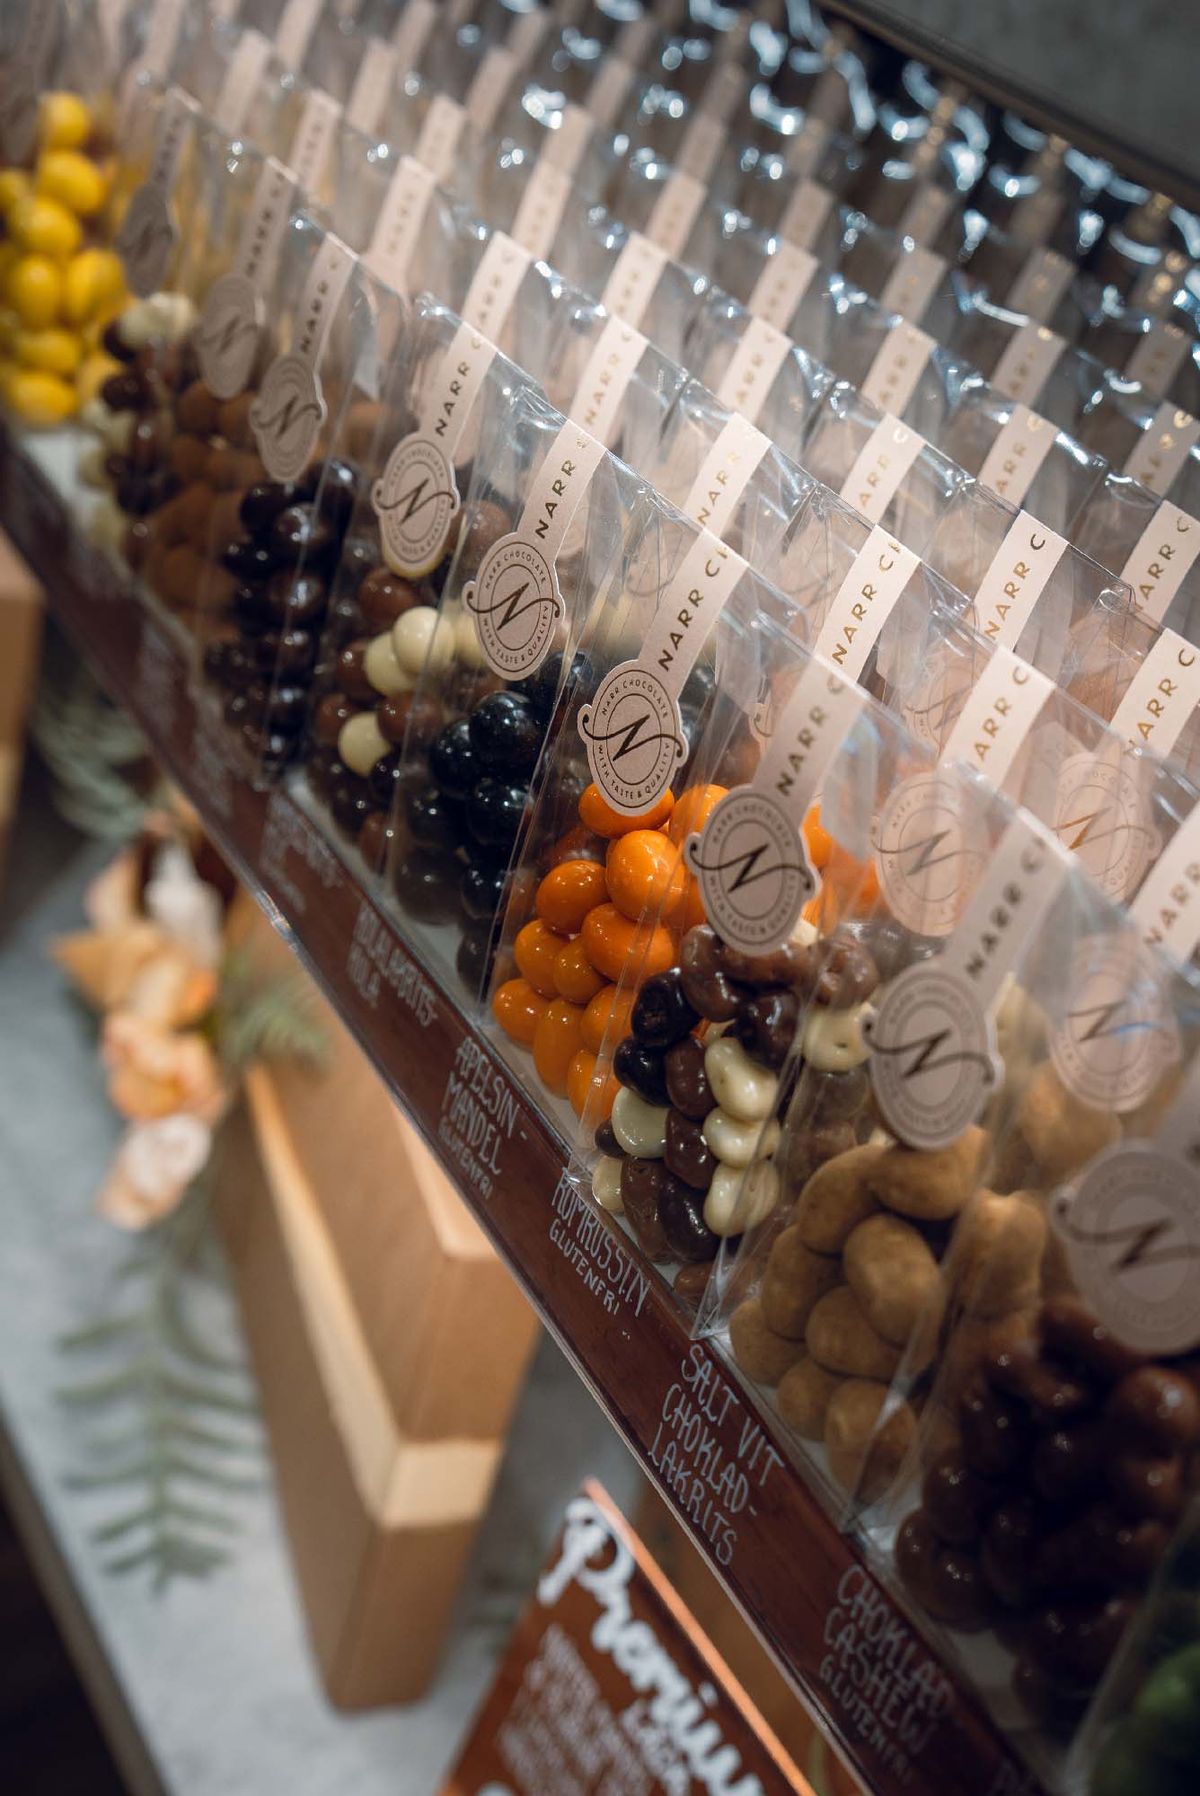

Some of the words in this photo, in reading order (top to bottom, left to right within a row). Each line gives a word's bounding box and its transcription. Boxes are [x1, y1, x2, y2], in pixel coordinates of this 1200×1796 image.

[434, 361, 471, 438] NARR
[535, 460, 576, 539] NARR
[860, 454, 890, 506] ARR
[996, 442, 1027, 494] ARR
[503, 550, 546, 584] CHOCOLATE
[984, 561, 1030, 641] NARR
[527, 605, 549, 657] QUALITY
[658, 588, 704, 672] NARR
[832, 584, 877, 665] NARR
[601, 686, 619, 716] NARR
[622, 678, 668, 719] CHOCOLATE
[974, 697, 1012, 762] ARR
[598, 744, 610, 777] WITH
[611, 779, 634, 799] TASTE
[644, 743, 670, 794] QUALITY
[776, 705, 827, 797] NARR
[441, 1070, 502, 1175] MANDEL
[549, 1218, 620, 1315] GLUTENFRI
[681, 1343, 739, 1427] SALT
[737, 1416, 785, 1486] VIT
[648, 1422, 738, 1566] LAKRITS
[823, 1606, 938, 1754] CASHEW
